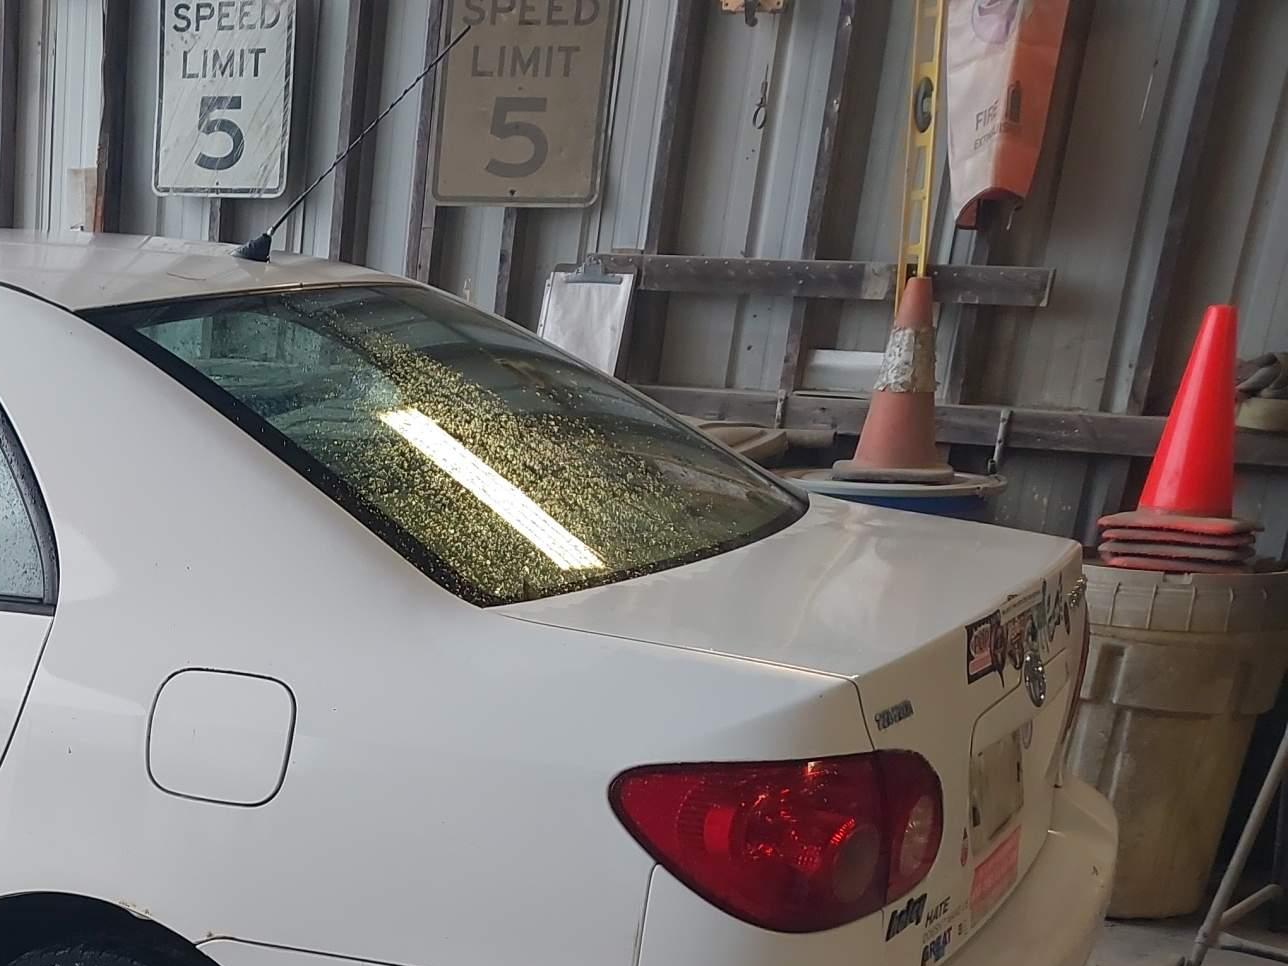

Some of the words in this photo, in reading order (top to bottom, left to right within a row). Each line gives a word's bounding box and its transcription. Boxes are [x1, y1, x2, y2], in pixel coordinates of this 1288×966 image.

[172, 1, 281, 33] SPEED
[462, 0, 600, 26] SPEED
[181, 47, 267, 79] LIMIT
[470, 45, 581, 78] LIMIT
[194, 95, 245, 171] 5
[485, 96, 549, 179] 5
